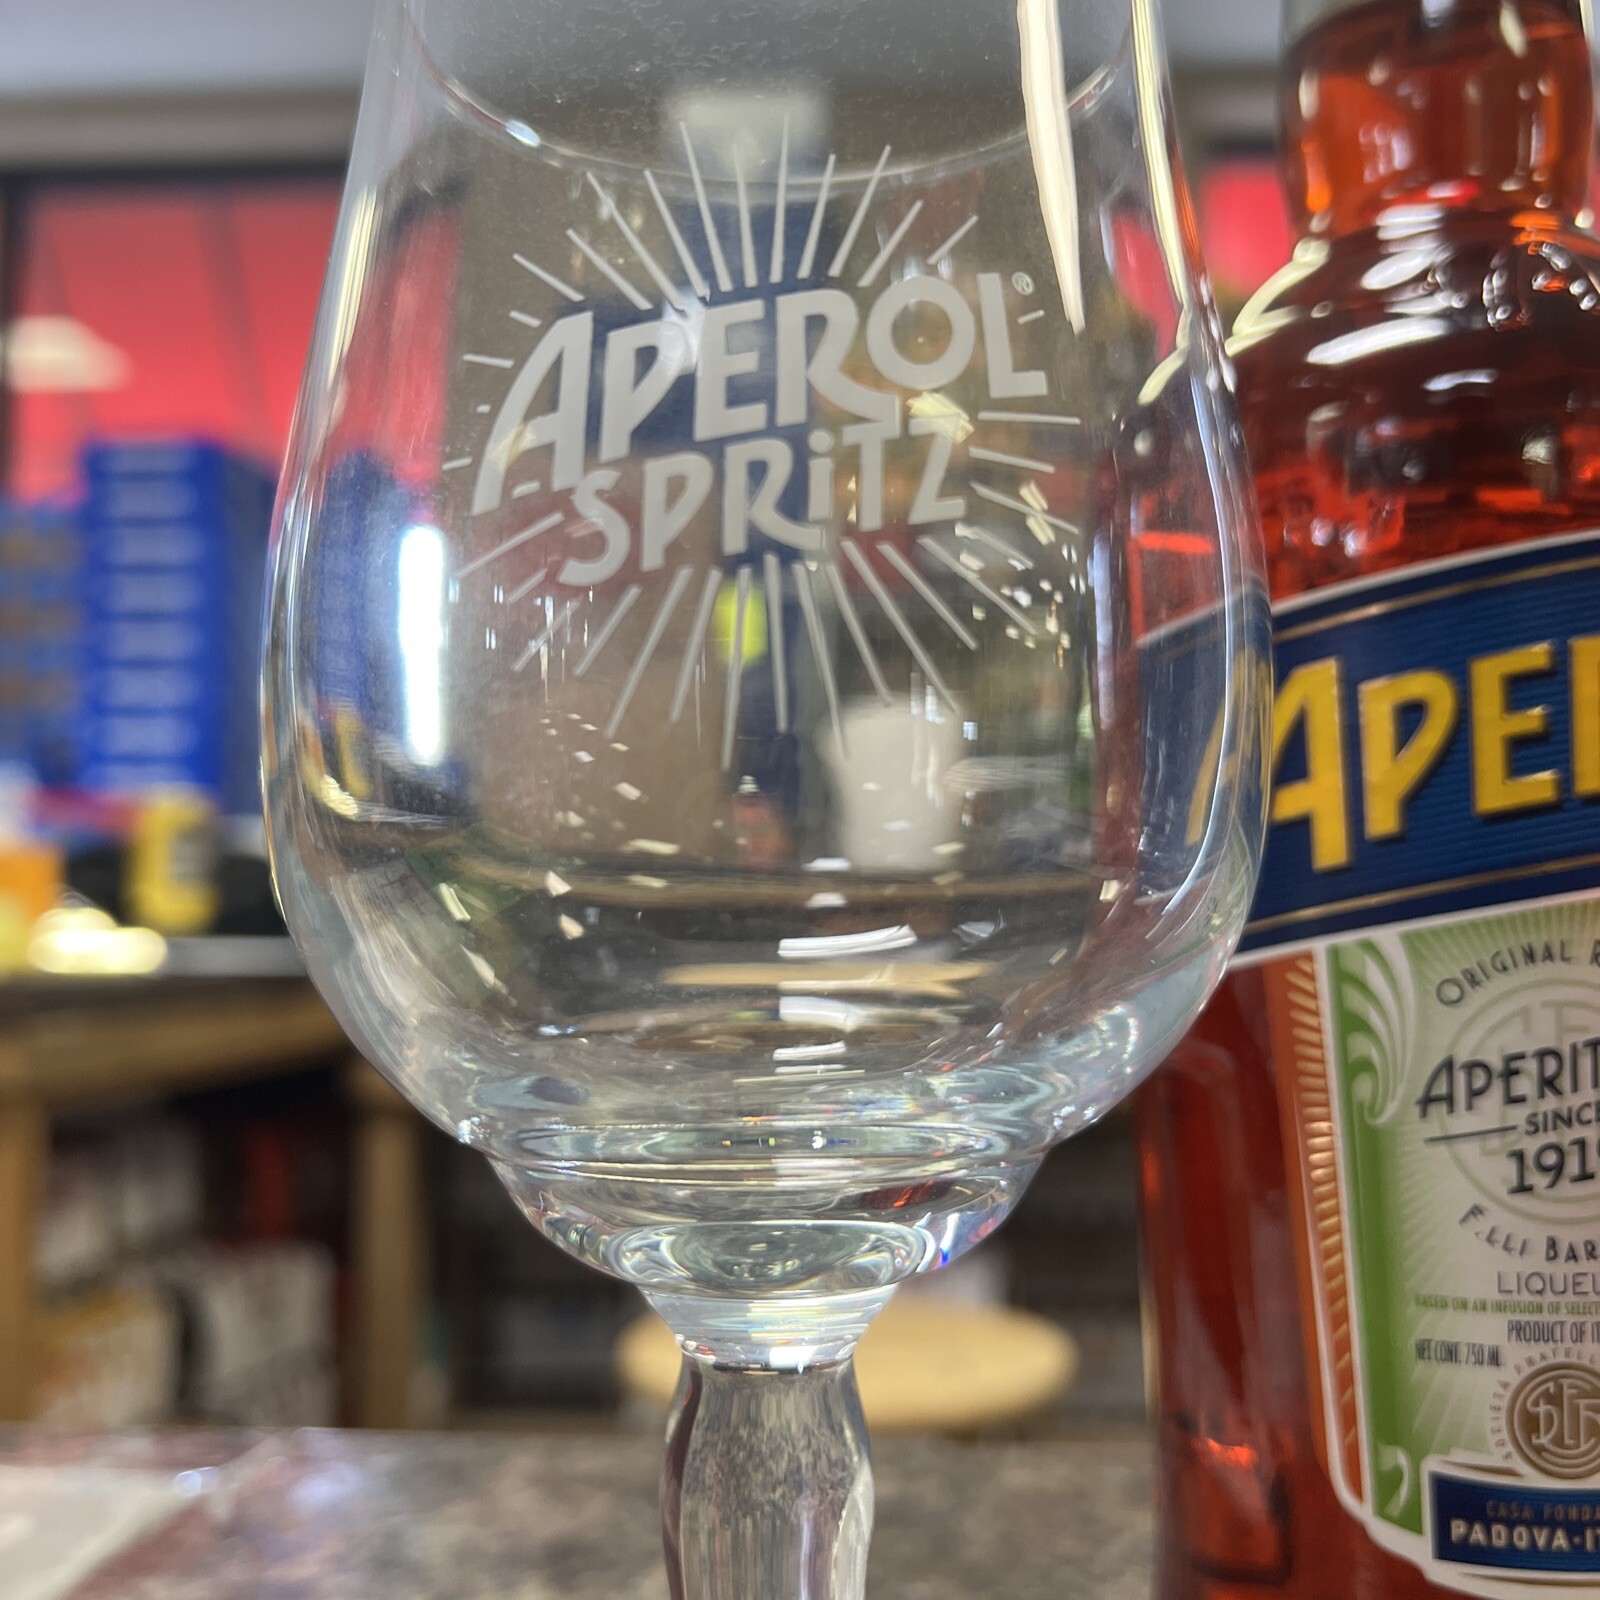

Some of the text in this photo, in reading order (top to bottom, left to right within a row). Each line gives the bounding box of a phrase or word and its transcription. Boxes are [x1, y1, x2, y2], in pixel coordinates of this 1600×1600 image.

[1435, 939, 1572, 1006] ORIGINAL
[1506, 1136, 1600, 1194] 191
[1490, 1300, 1543, 1315] INFUSION
[1507, 1319, 1566, 1343] PRODUCT
[1569, 1321, 1587, 1342] OF
[1415, 1339, 1433, 1361] NET
